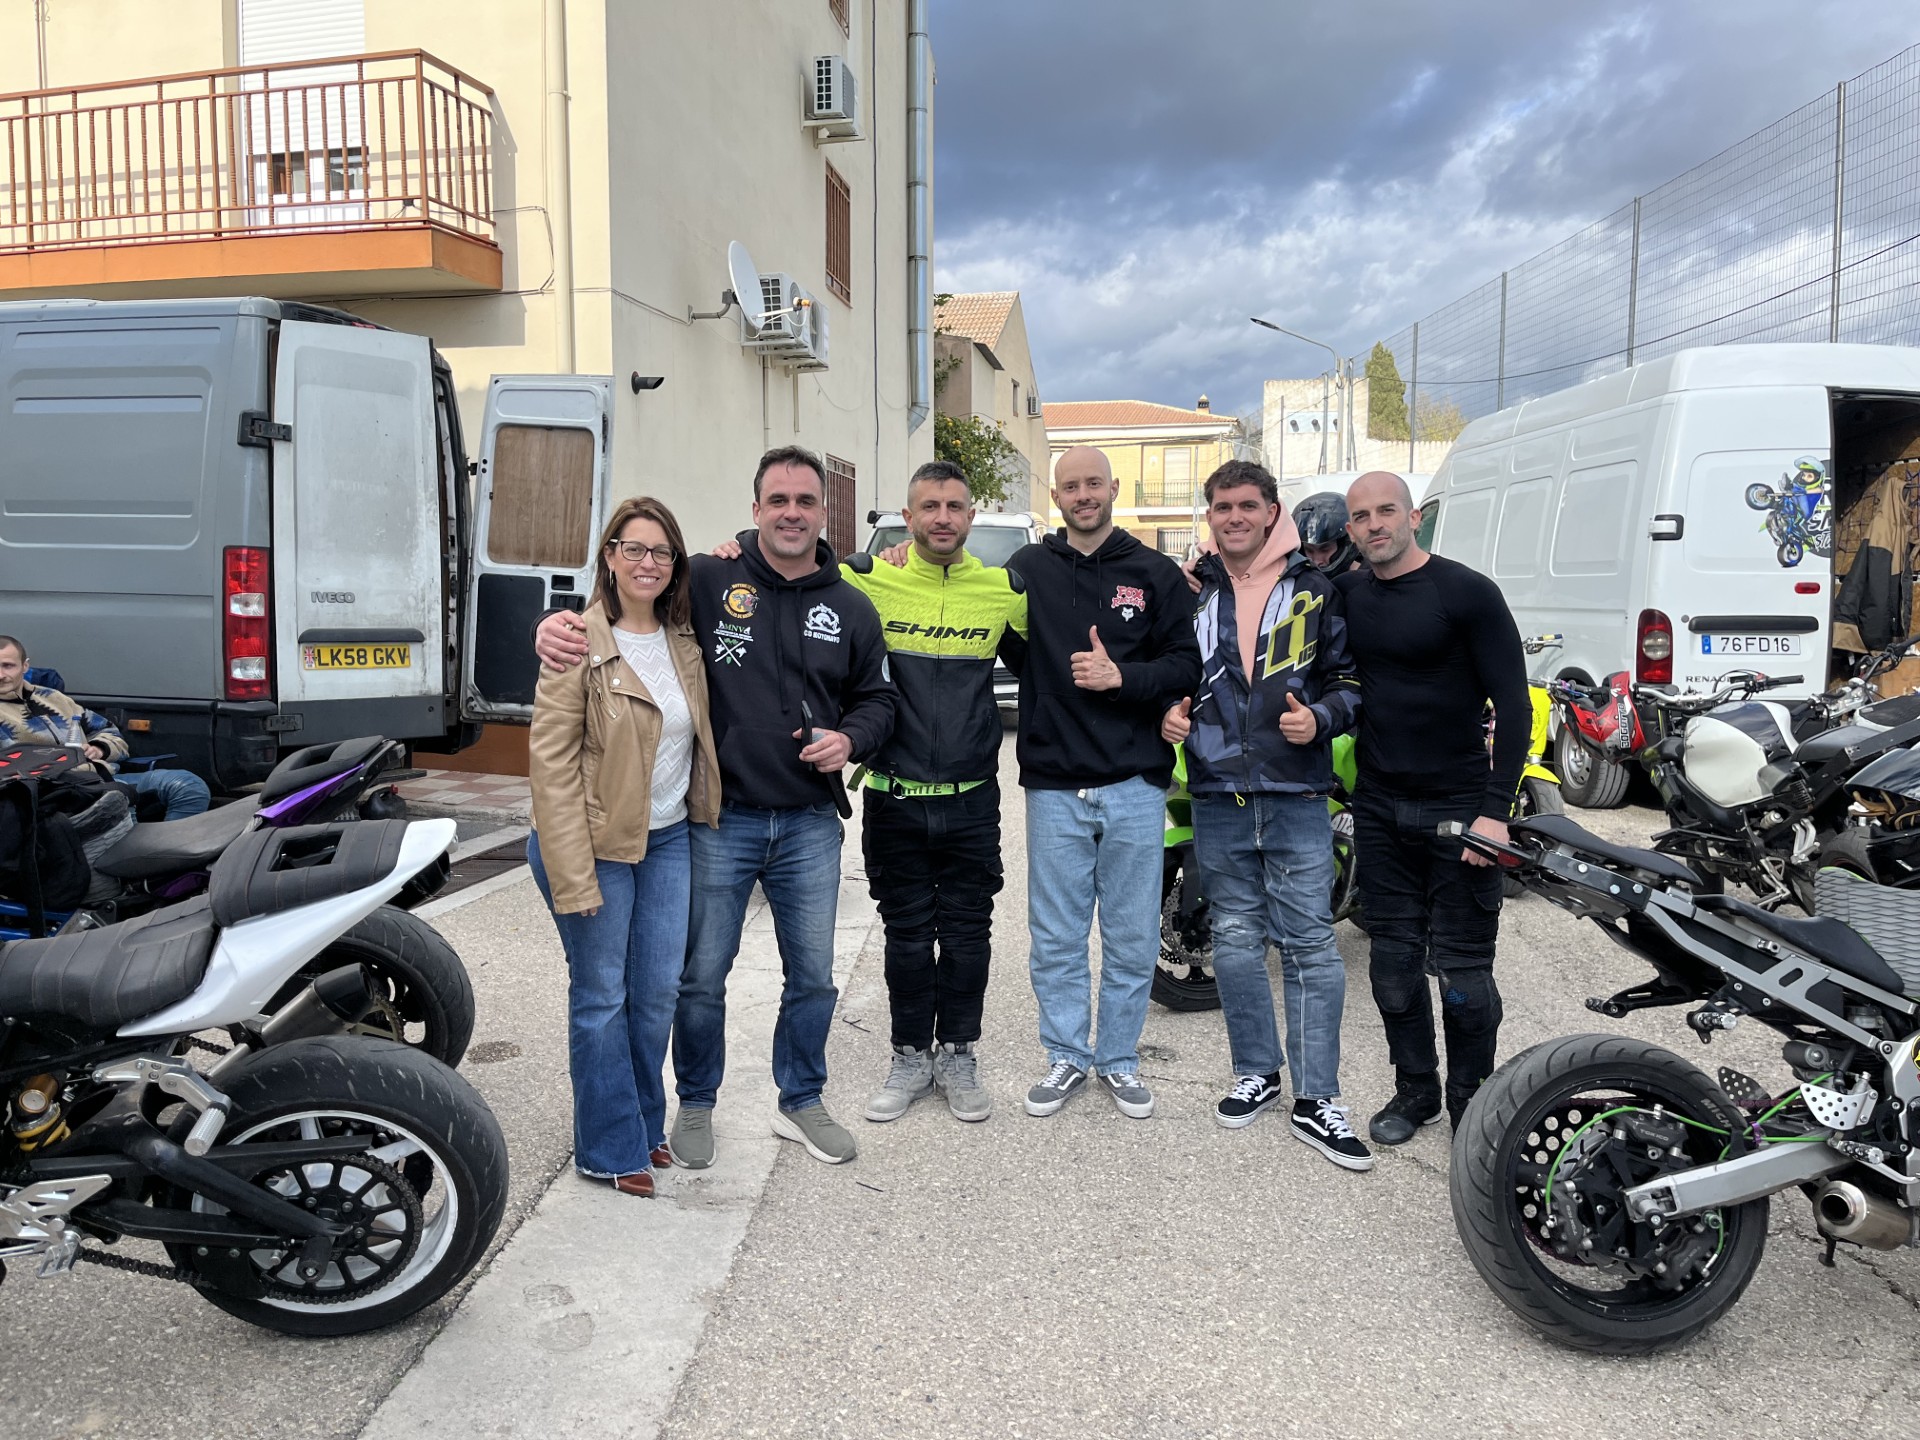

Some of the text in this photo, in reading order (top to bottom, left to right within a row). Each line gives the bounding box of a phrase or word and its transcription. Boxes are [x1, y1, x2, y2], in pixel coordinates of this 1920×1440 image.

[311, 591, 356, 604] IVECO
[1116, 585, 1144, 600] FOX
[884, 620, 991, 640] SHIMA
[316, 647, 407, 667] LK58 GKV
[1685, 675, 1730, 683] RENAU
